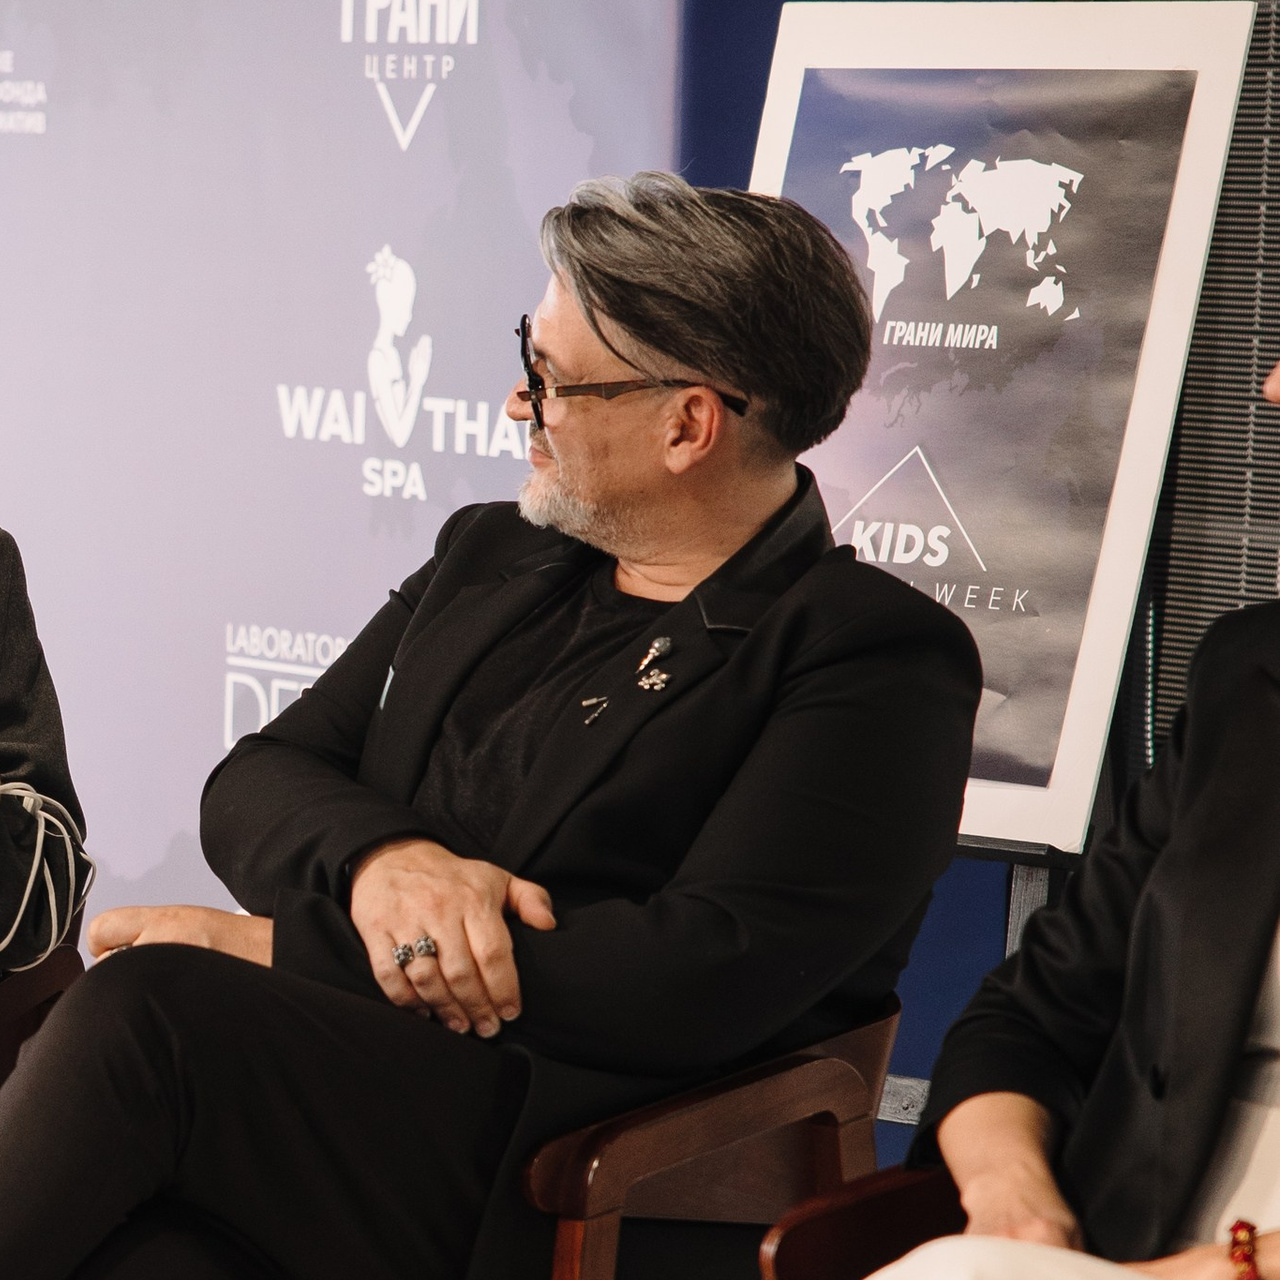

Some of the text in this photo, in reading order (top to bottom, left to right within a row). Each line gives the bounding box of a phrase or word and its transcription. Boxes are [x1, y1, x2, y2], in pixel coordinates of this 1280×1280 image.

[364, 53, 456, 84] ЦЕНТР
[883, 321, 998, 349] ГРАНИ МИРА
[277, 383, 366, 445] WAI
[362, 456, 427, 501] SPA
[851, 520, 952, 567] KIDS
[935, 582, 1029, 612] WEEK
[226, 623, 353, 667] LABORATOR
